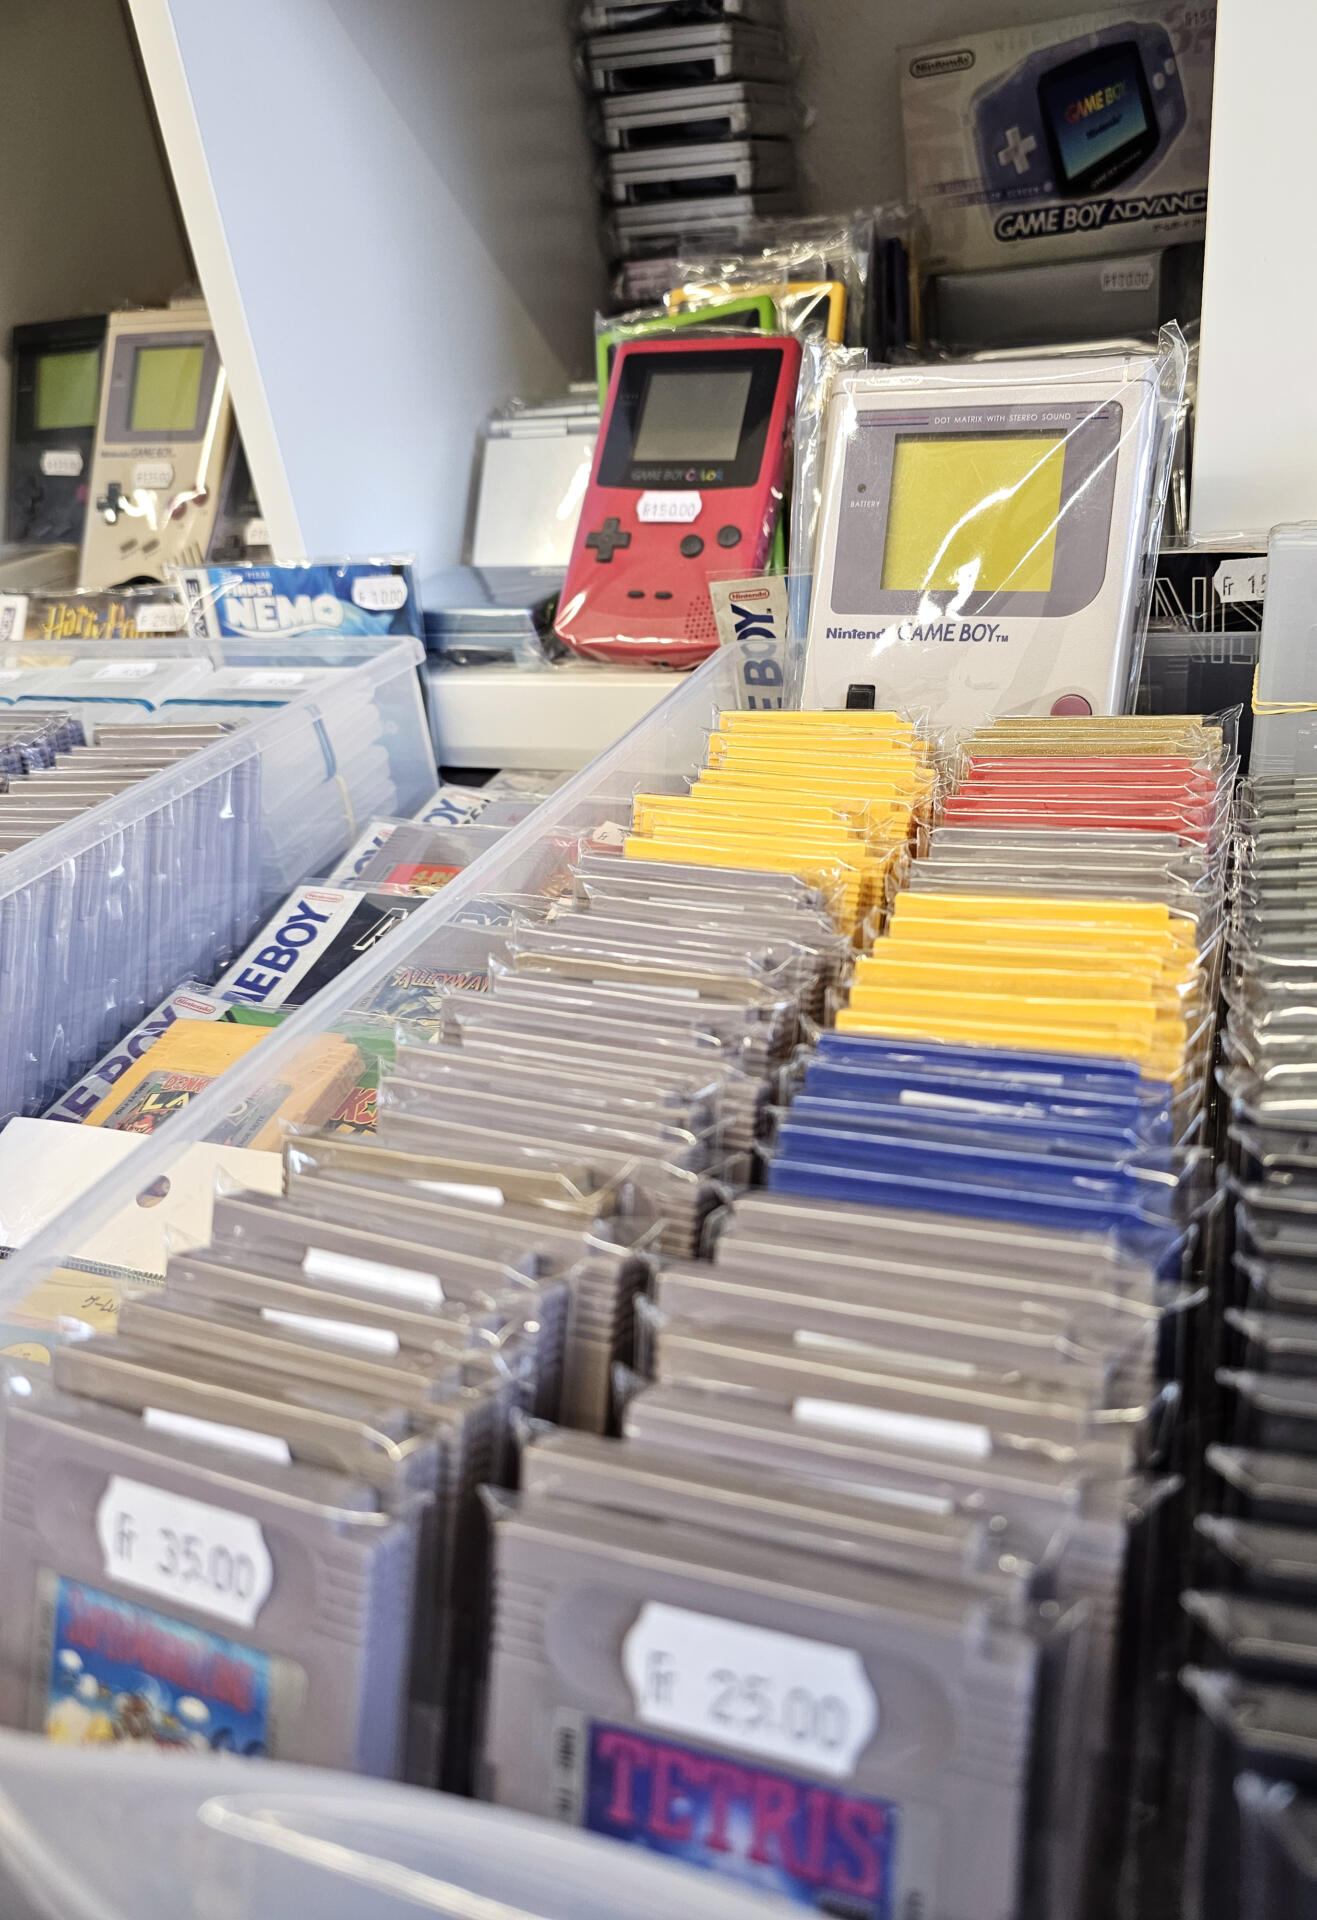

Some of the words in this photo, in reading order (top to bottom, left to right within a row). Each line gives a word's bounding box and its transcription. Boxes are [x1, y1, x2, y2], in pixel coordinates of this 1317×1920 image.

[998, 207, 1059, 239] GAME
[1062, 202, 1108, 230] BOY
[934, 417, 950, 425] DOT
[954, 415, 983, 424] MATRIX
[986, 414, 1005, 423] WITH
[1009, 413, 1038, 423] STEREO
[1041, 412, 1071, 422] SOUND
[630, 467, 662, 482] GAME
[663, 467, 684, 481] BOY
[685, 467, 723, 482] CLOR
[850, 500, 881, 509] BATTERY
[730, 590, 768, 600] Nintendo
[1223, 577, 1234, 596] Fr
[225, 594, 344, 632] NEMO
[730, 603, 784, 687] BOY
[826, 627, 888, 640] Nintend
[958, 623, 1000, 643] BOY
[252, 900, 330, 974] BOY
[157, 1526, 256, 1600] 35.00
[705, 1667, 851, 1749] 25.00
[596, 1729, 887, 1900] TETRIS
